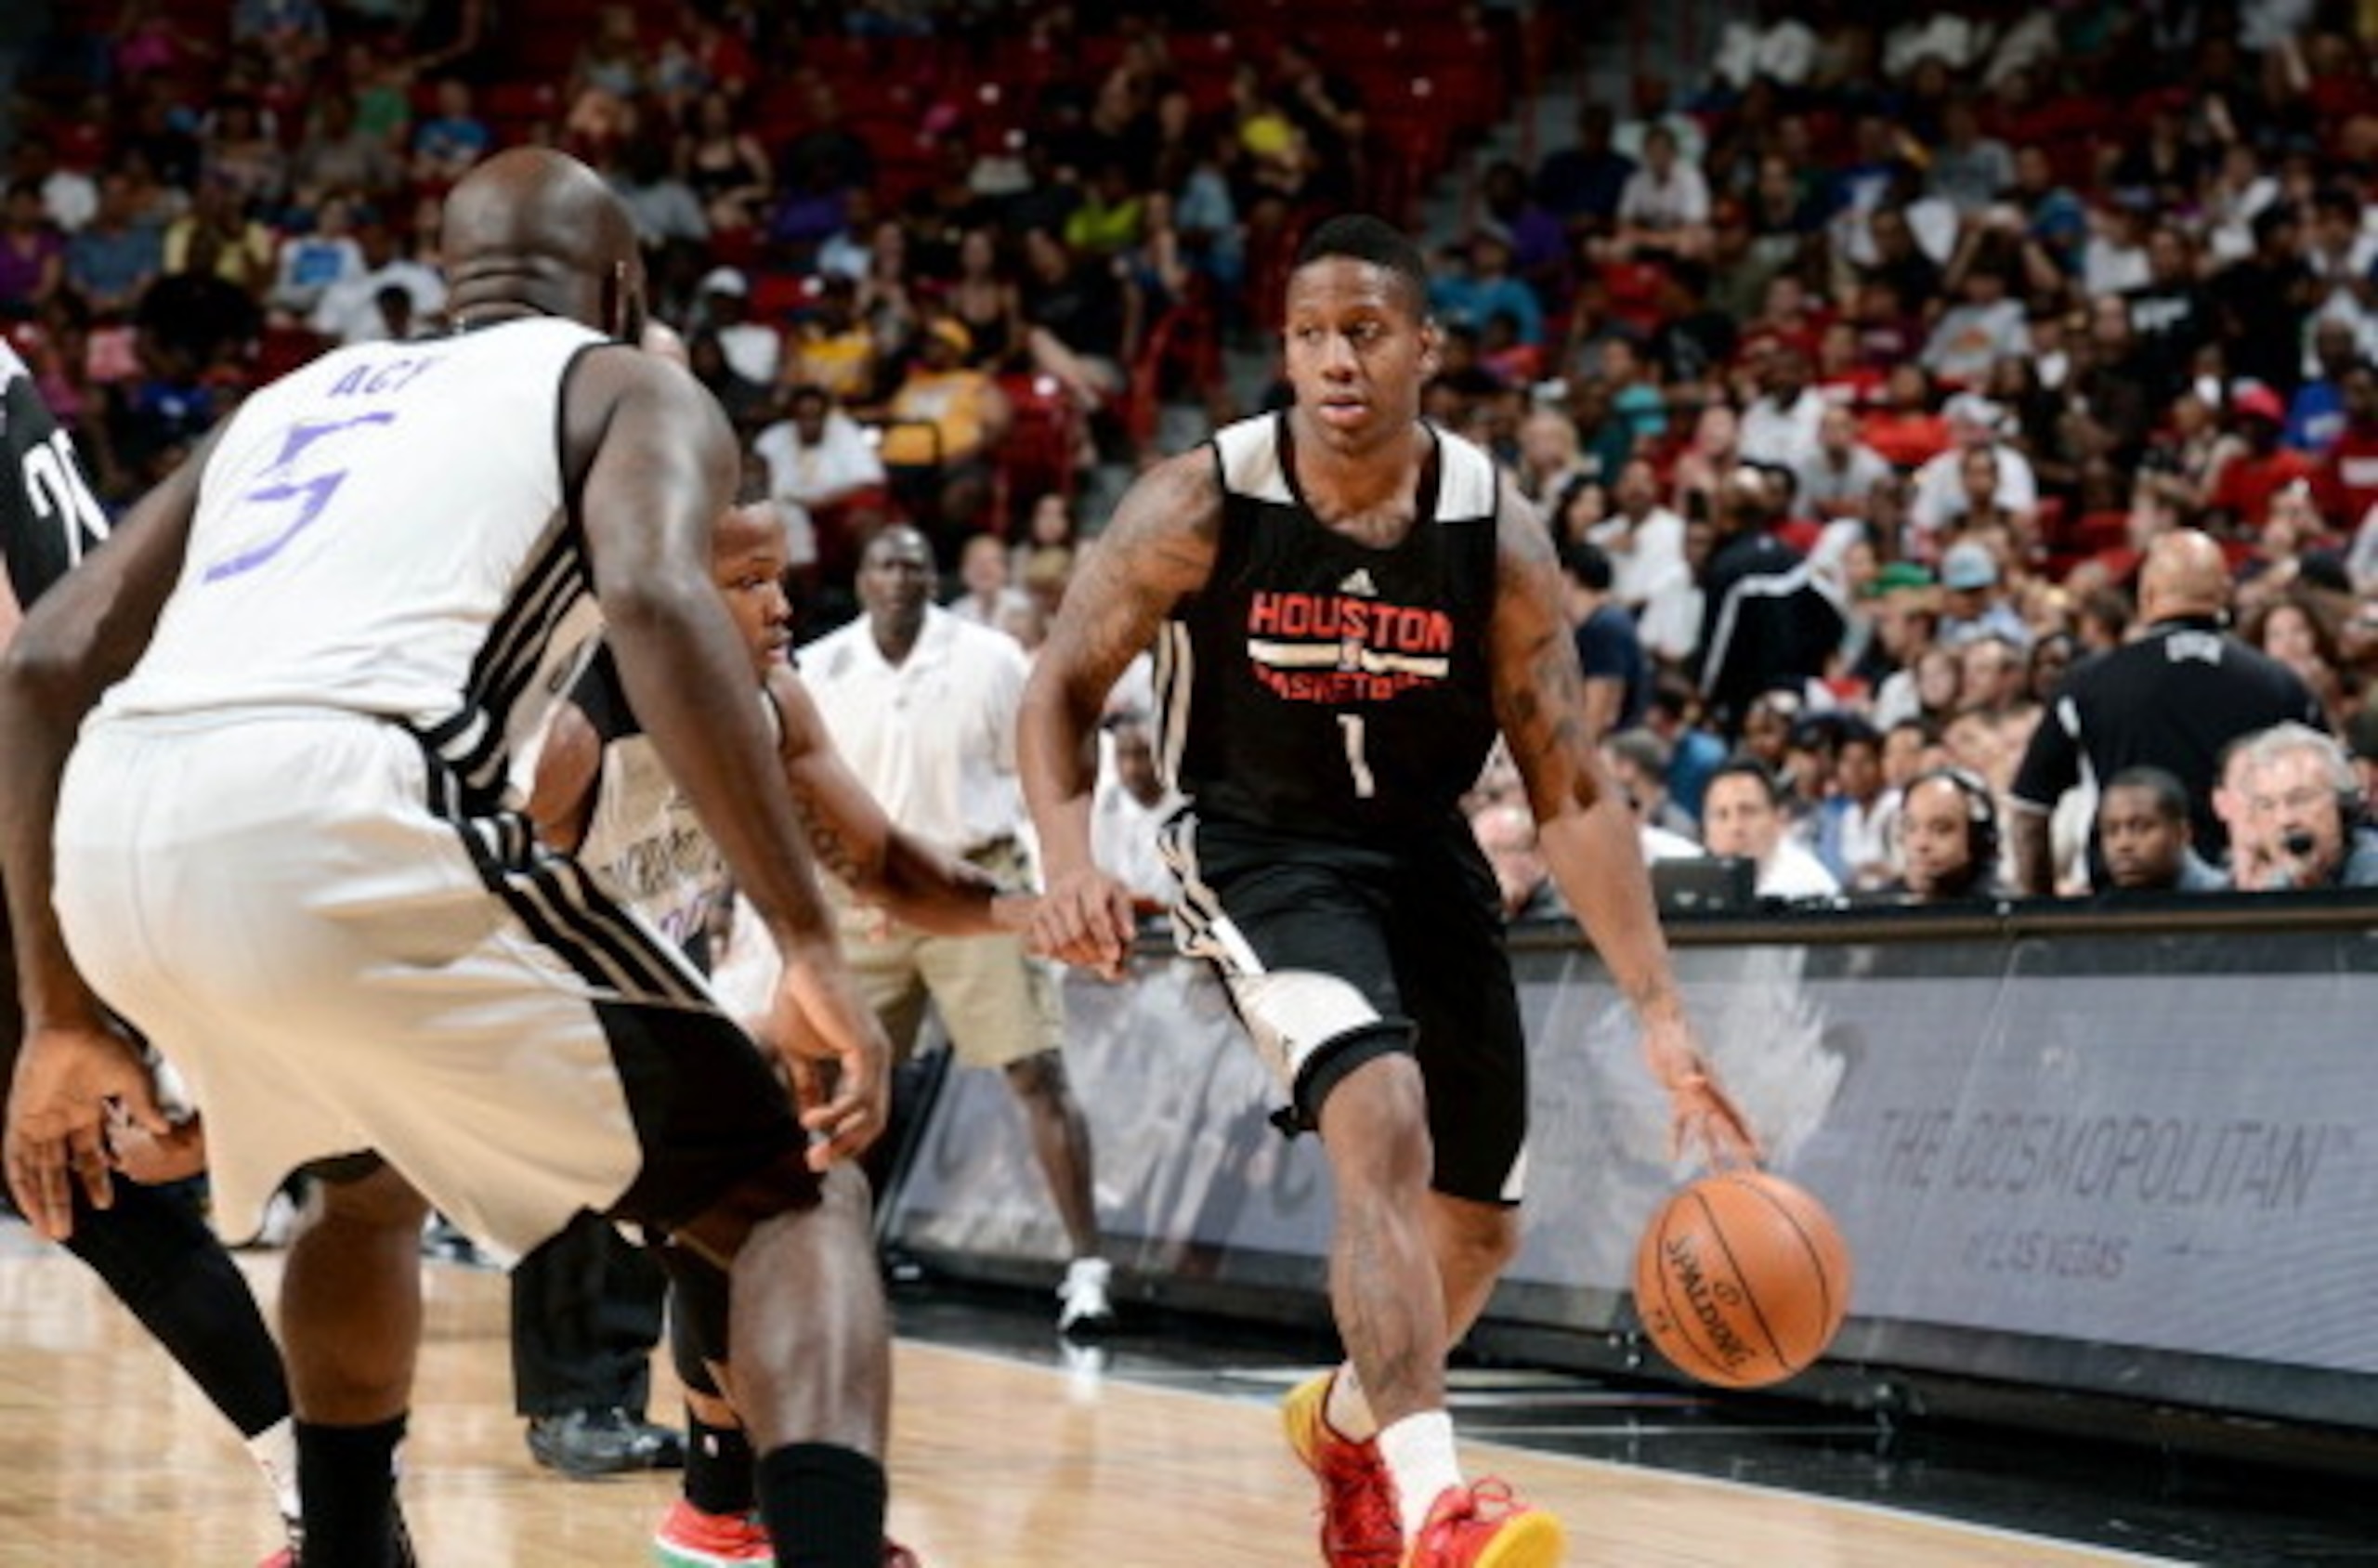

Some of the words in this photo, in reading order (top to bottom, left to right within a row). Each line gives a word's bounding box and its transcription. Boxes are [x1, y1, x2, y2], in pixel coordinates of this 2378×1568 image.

[201, 410, 397, 584] 5
[1248, 591, 1454, 652] HOUSTON
[1336, 712, 1375, 799] 1
[1879, 1110, 1951, 1190] THE
[1953, 1112, 2332, 1210] COSMOPOLITAN
